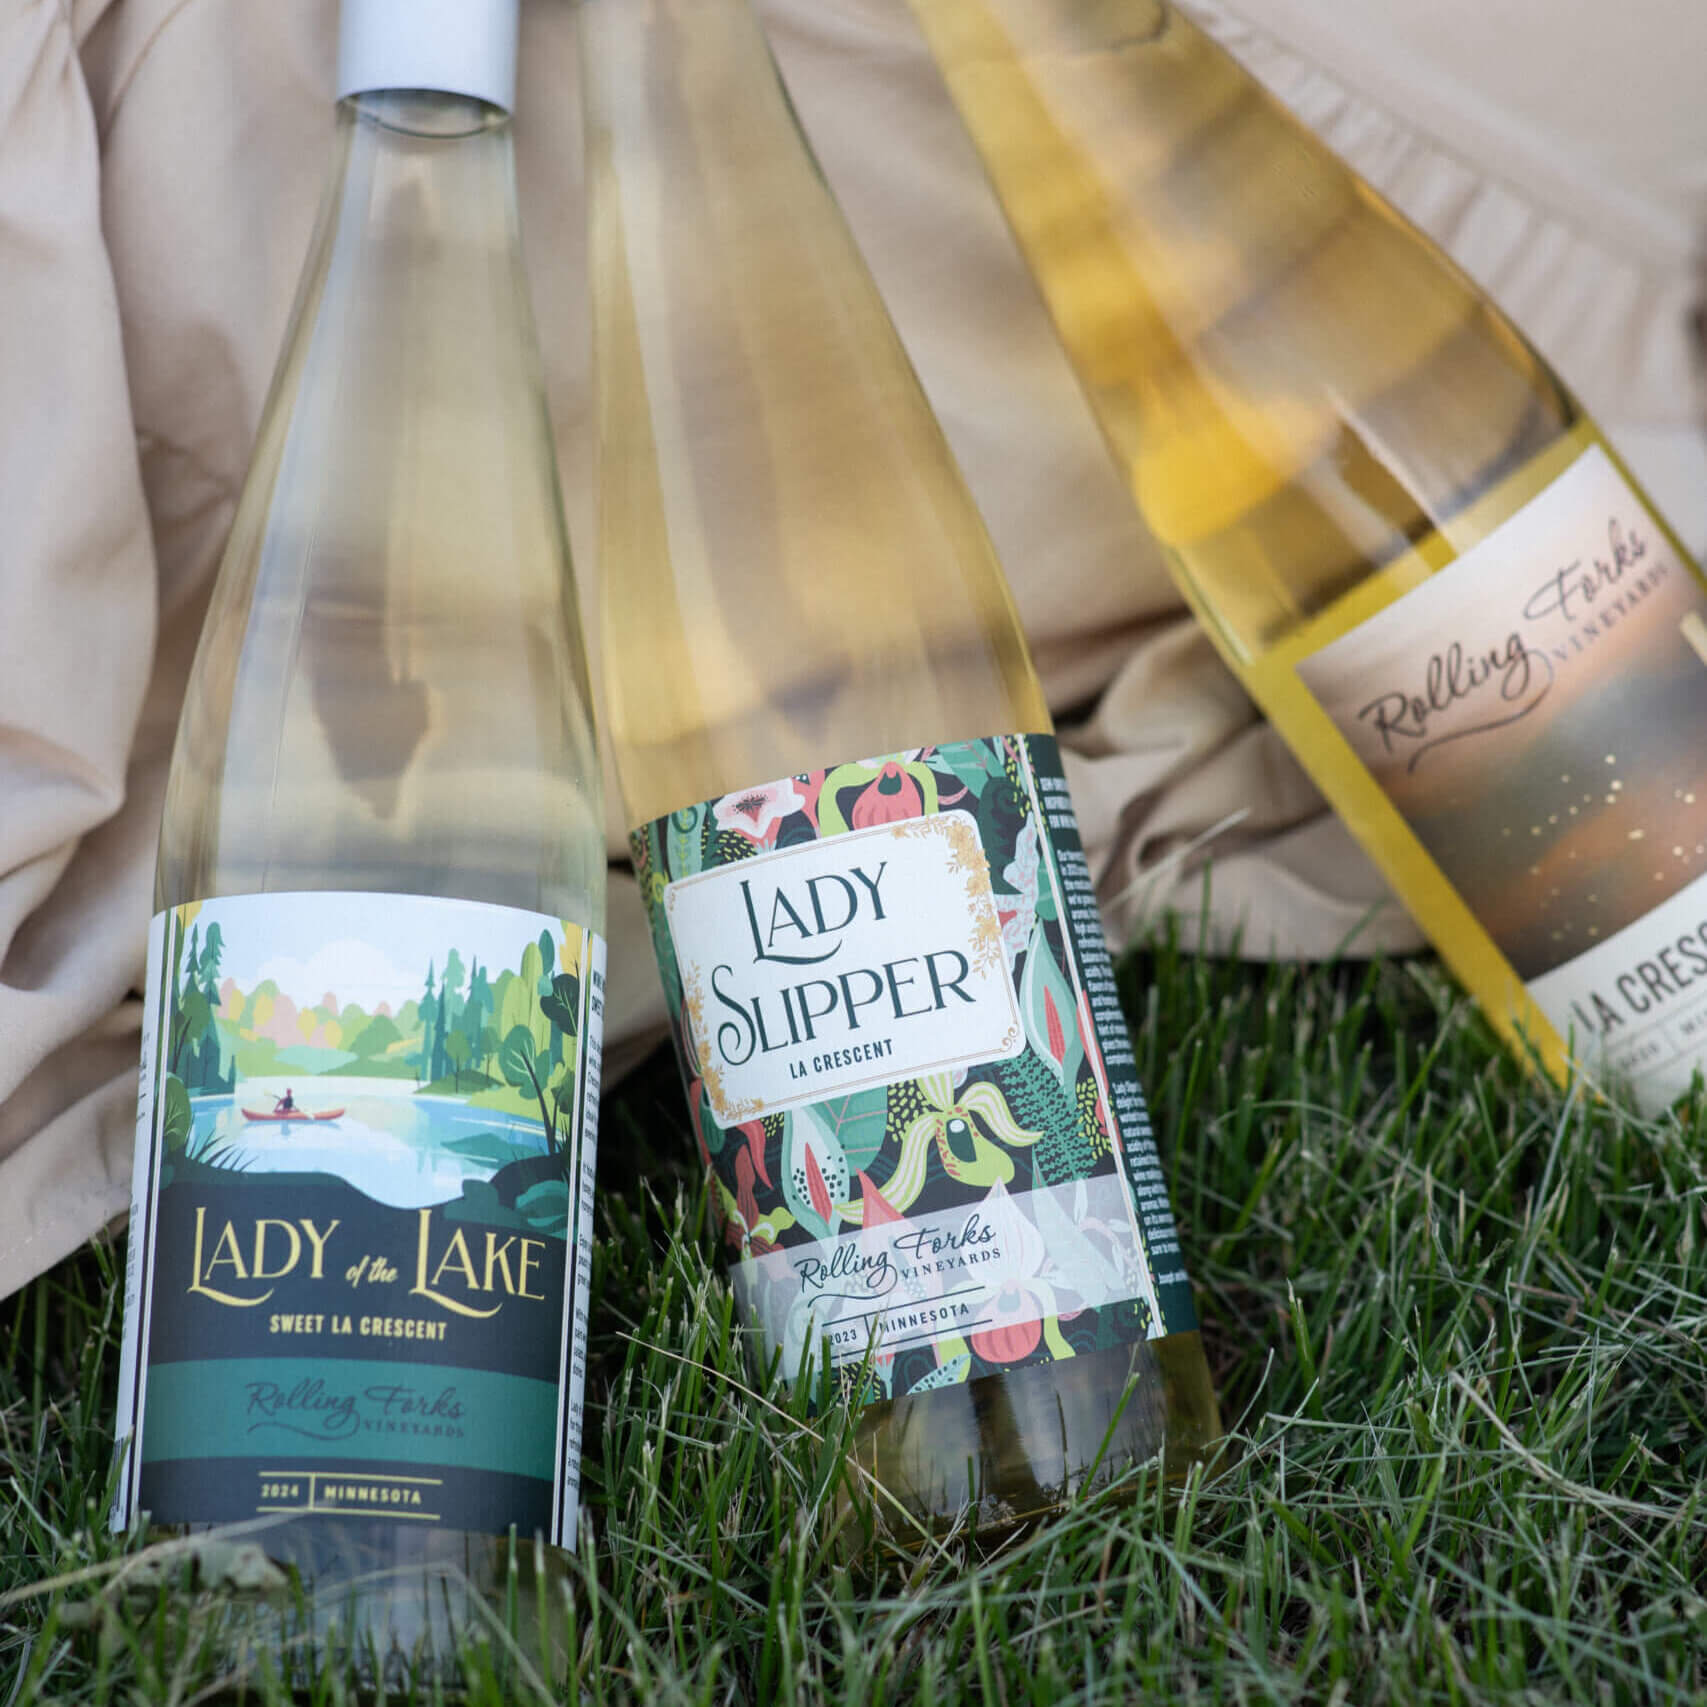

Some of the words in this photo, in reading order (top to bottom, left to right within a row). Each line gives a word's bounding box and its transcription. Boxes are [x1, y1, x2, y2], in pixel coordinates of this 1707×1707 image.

[1551, 560, 1671, 662] VINEYARDS
[1357, 633, 1554, 775] Rolling
[1524, 517, 1646, 622] Forks
[739, 861, 889, 966] LADY
[711, 950, 977, 1067] SLIPPER
[789, 1059, 808, 1080] LA
[813, 1038, 895, 1073] CRESCENT
[187, 1207, 341, 1307] LADY
[345, 1254, 370, 1288] of
[367, 1254, 398, 1283] the
[408, 1209, 546, 1318] LAKE
[794, 1243, 898, 1308] Rolling
[894, 1213, 997, 1260] Forks
[901, 1247, 1001, 1280] VINEYARDS
[269, 1314, 324, 1333] SWEET
[331, 1315, 353, 1334] LA
[360, 1316, 447, 1341] CRESCENT
[828, 1328, 858, 1347] 2023
[879, 1302, 970, 1333] MINNESOTA
[245, 1377, 360, 1441] Rolling
[363, 1385, 466, 1419] Forks
[364, 1418, 465, 1439] VINEYARDS
[261, 1483, 300, 1499] 2024
[324, 1485, 422, 1505] MINNESOTA
